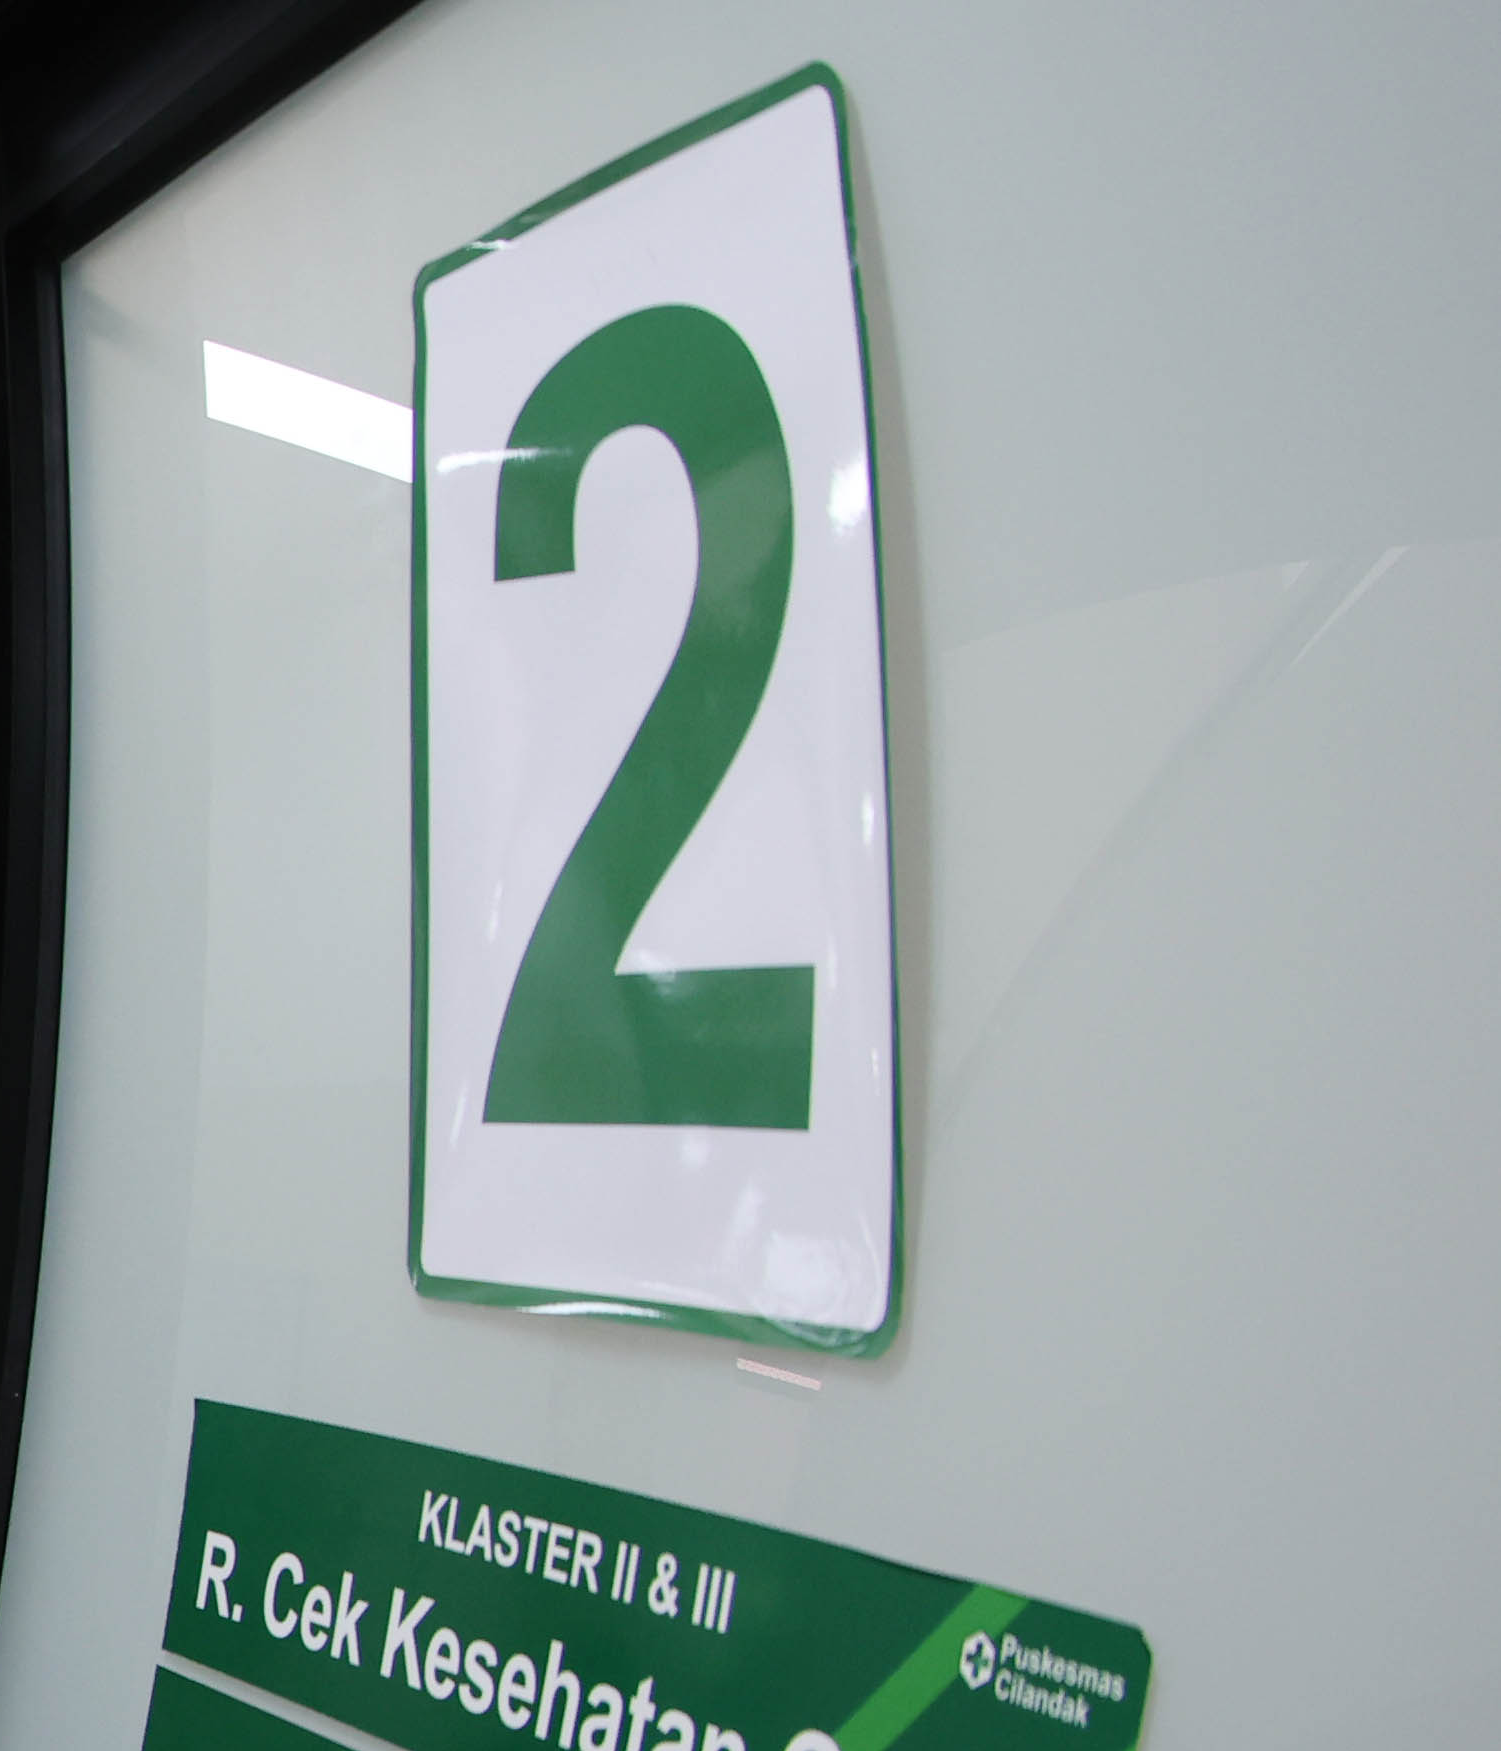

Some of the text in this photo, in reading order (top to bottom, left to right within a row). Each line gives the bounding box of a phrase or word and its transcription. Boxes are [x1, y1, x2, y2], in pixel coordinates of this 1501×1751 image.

[482, 303, 815, 1131] 2
[196, 1530, 242, 1622] R.
[263, 1551, 369, 1666] Cek
[418, 1490, 736, 1633] KLASTER II & III
[995, 1668, 1090, 1728] Cilandak
[1000, 1633, 1126, 1701] Puskesmas
